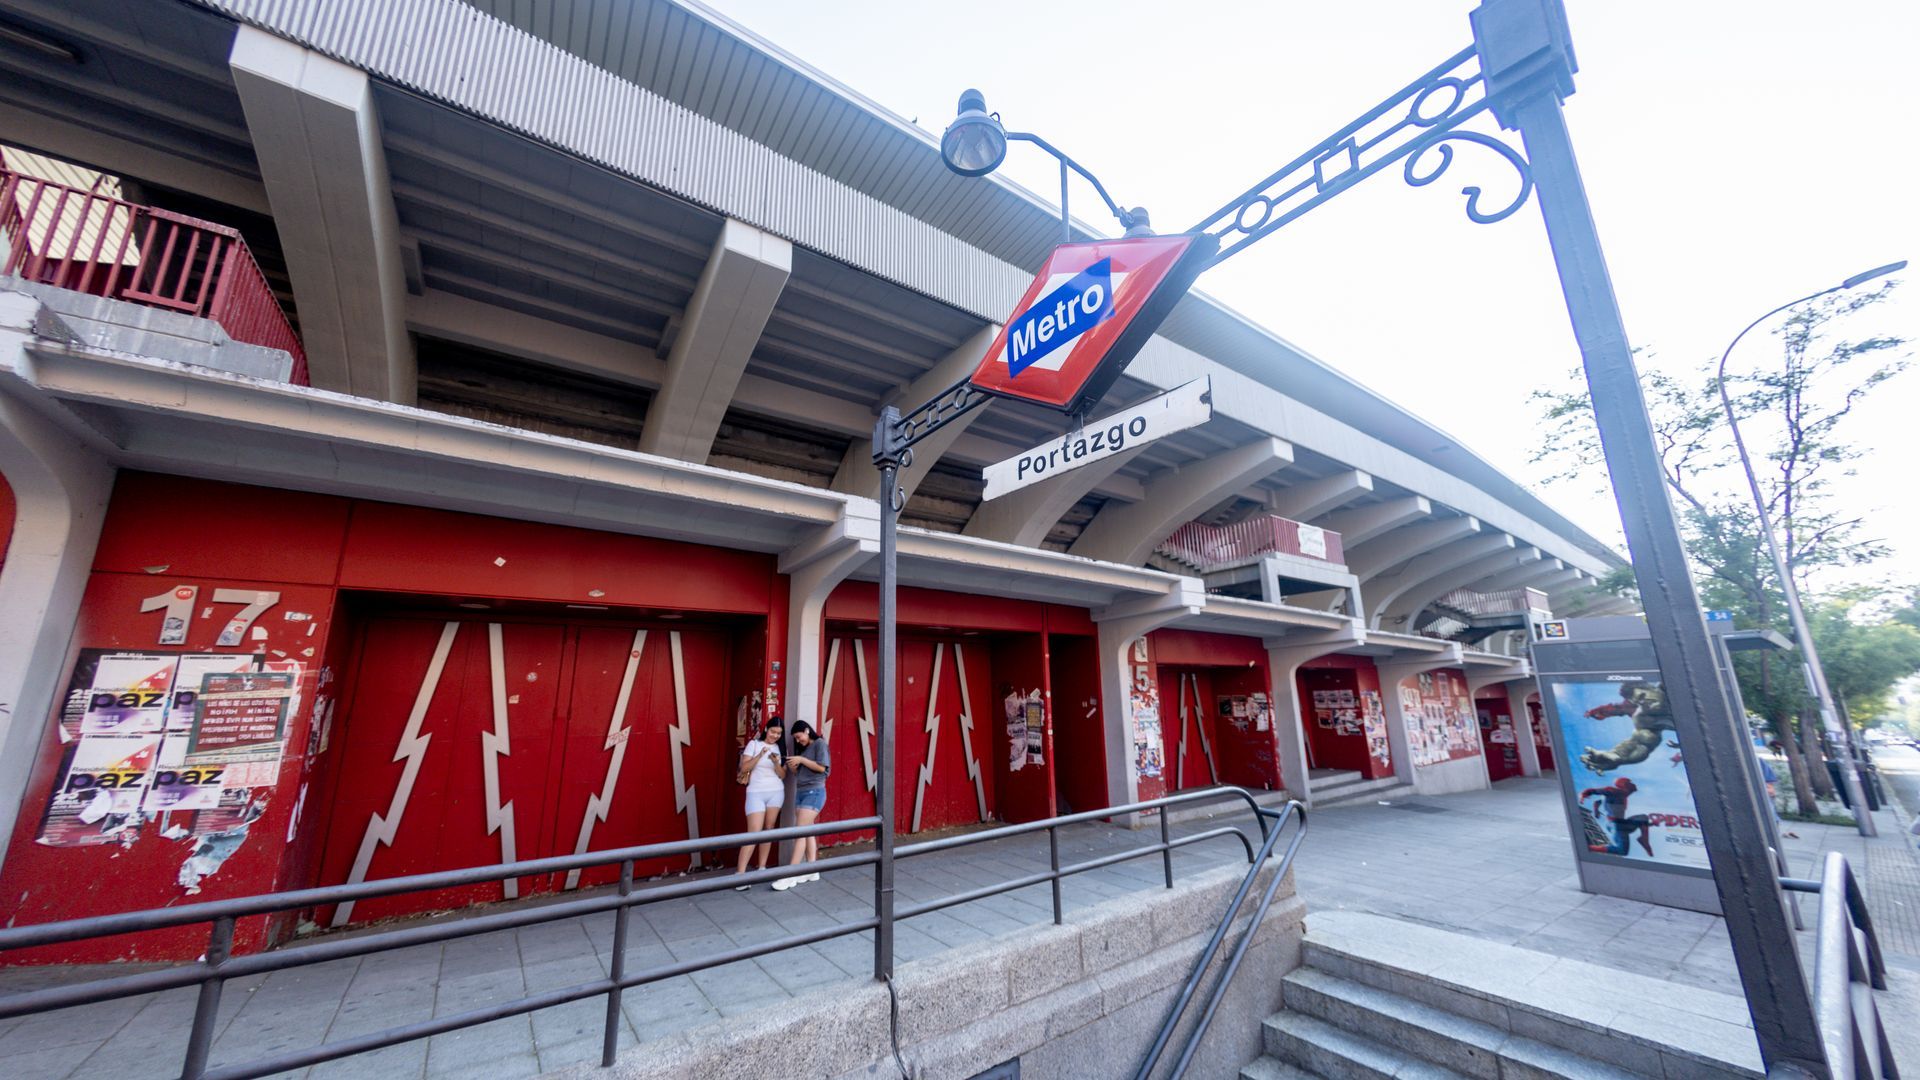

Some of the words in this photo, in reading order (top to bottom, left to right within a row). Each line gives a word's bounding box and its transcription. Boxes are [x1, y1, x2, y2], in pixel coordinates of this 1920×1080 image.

[1012, 283, 1104, 362] Metro
[1017, 415, 1148, 481] Portazgo
[140, 585, 281, 646] 17
[88, 693, 164, 712] paz
[64, 772, 145, 794] paz
[151, 770, 224, 790] paz
